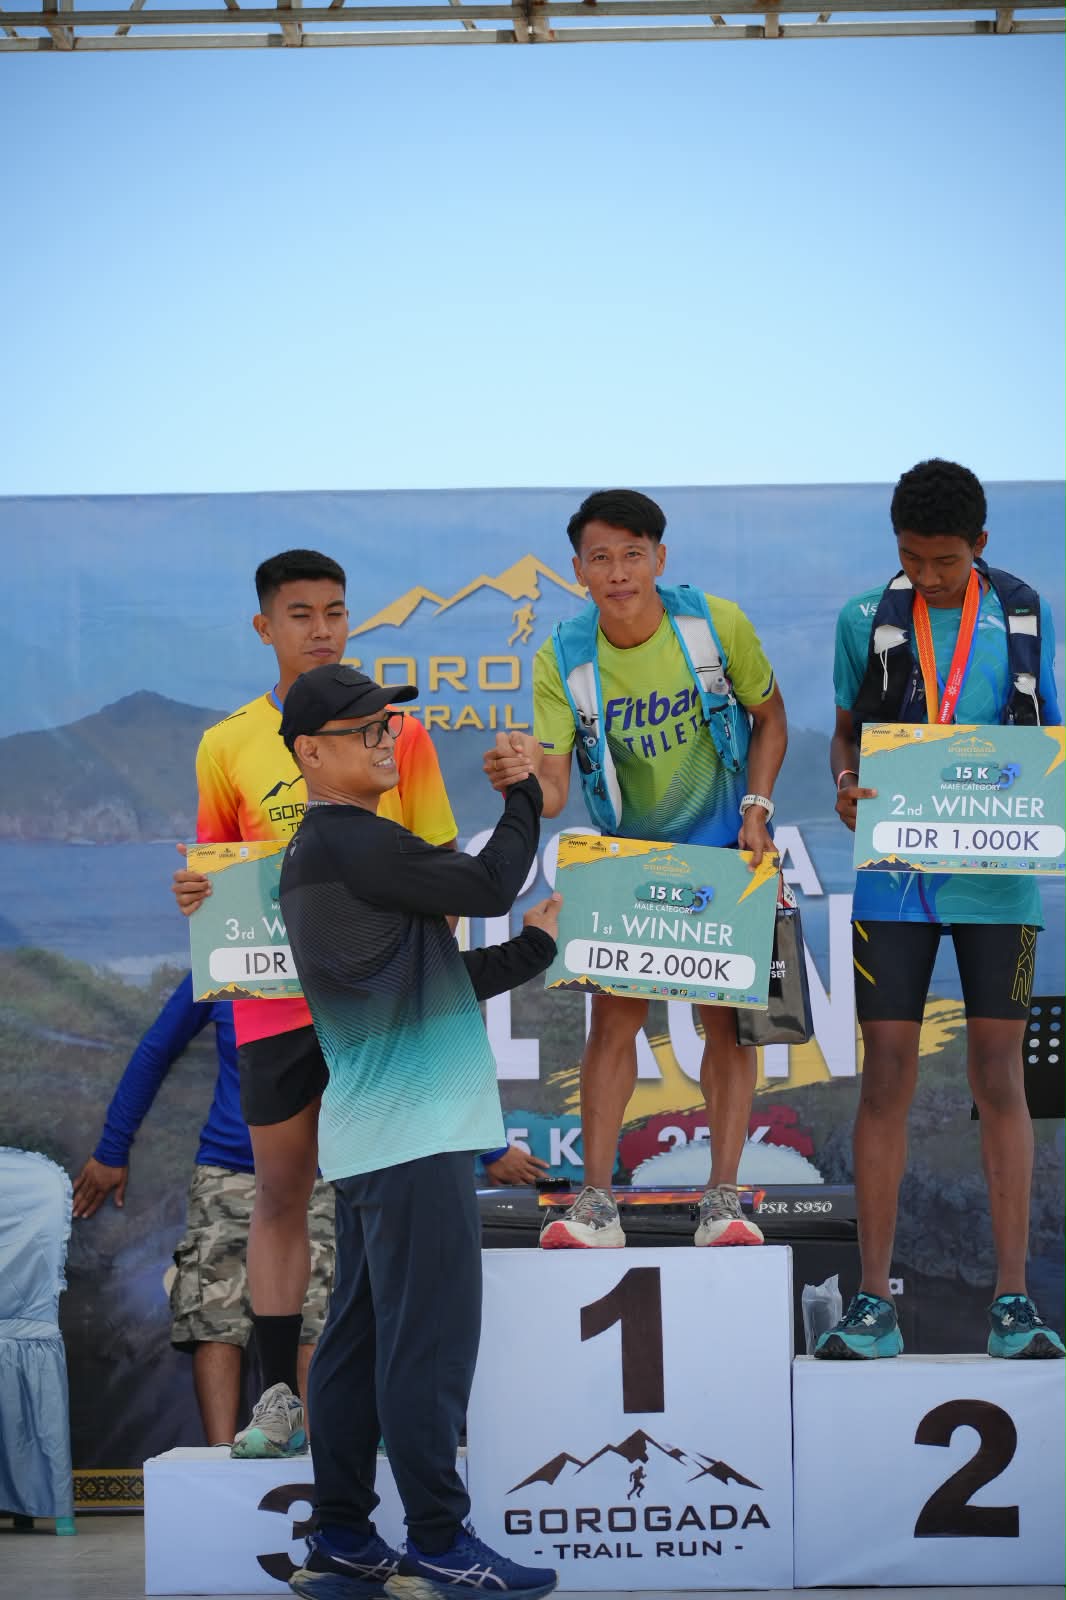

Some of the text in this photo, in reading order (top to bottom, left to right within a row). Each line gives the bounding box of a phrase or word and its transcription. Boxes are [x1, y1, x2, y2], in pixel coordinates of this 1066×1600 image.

[340, 656, 520, 692] ORO
[398, 704, 529, 731] RAIL
[623, 715, 699, 758] THLET
[955, 767, 989, 779] 15 K
[940, 783, 1001, 792] MALE CATEGORY
[269, 803, 308, 822] GOR
[891, 795, 1045, 818] 2nd WINNER
[897, 827, 1040, 851] IDR 1.000K
[650, 885, 684, 901] 15 K
[634, 903, 694, 915] MALE CATEGORY
[225, 918, 255, 941] 3rd
[621, 913, 733, 947] WINNER
[245, 952, 288, 974] IDR
[588, 946, 731, 981] IDR 2.000K
[758, 1201, 833, 1215] PSR S950
[580, 1266, 664, 1414] 1
[913, 1399, 1020, 1538] 2
[504, 1503, 771, 1535] GOROGADA
[552, 1542, 643, 1560] TRAIL
[655, 1540, 723, 1558] RUN
